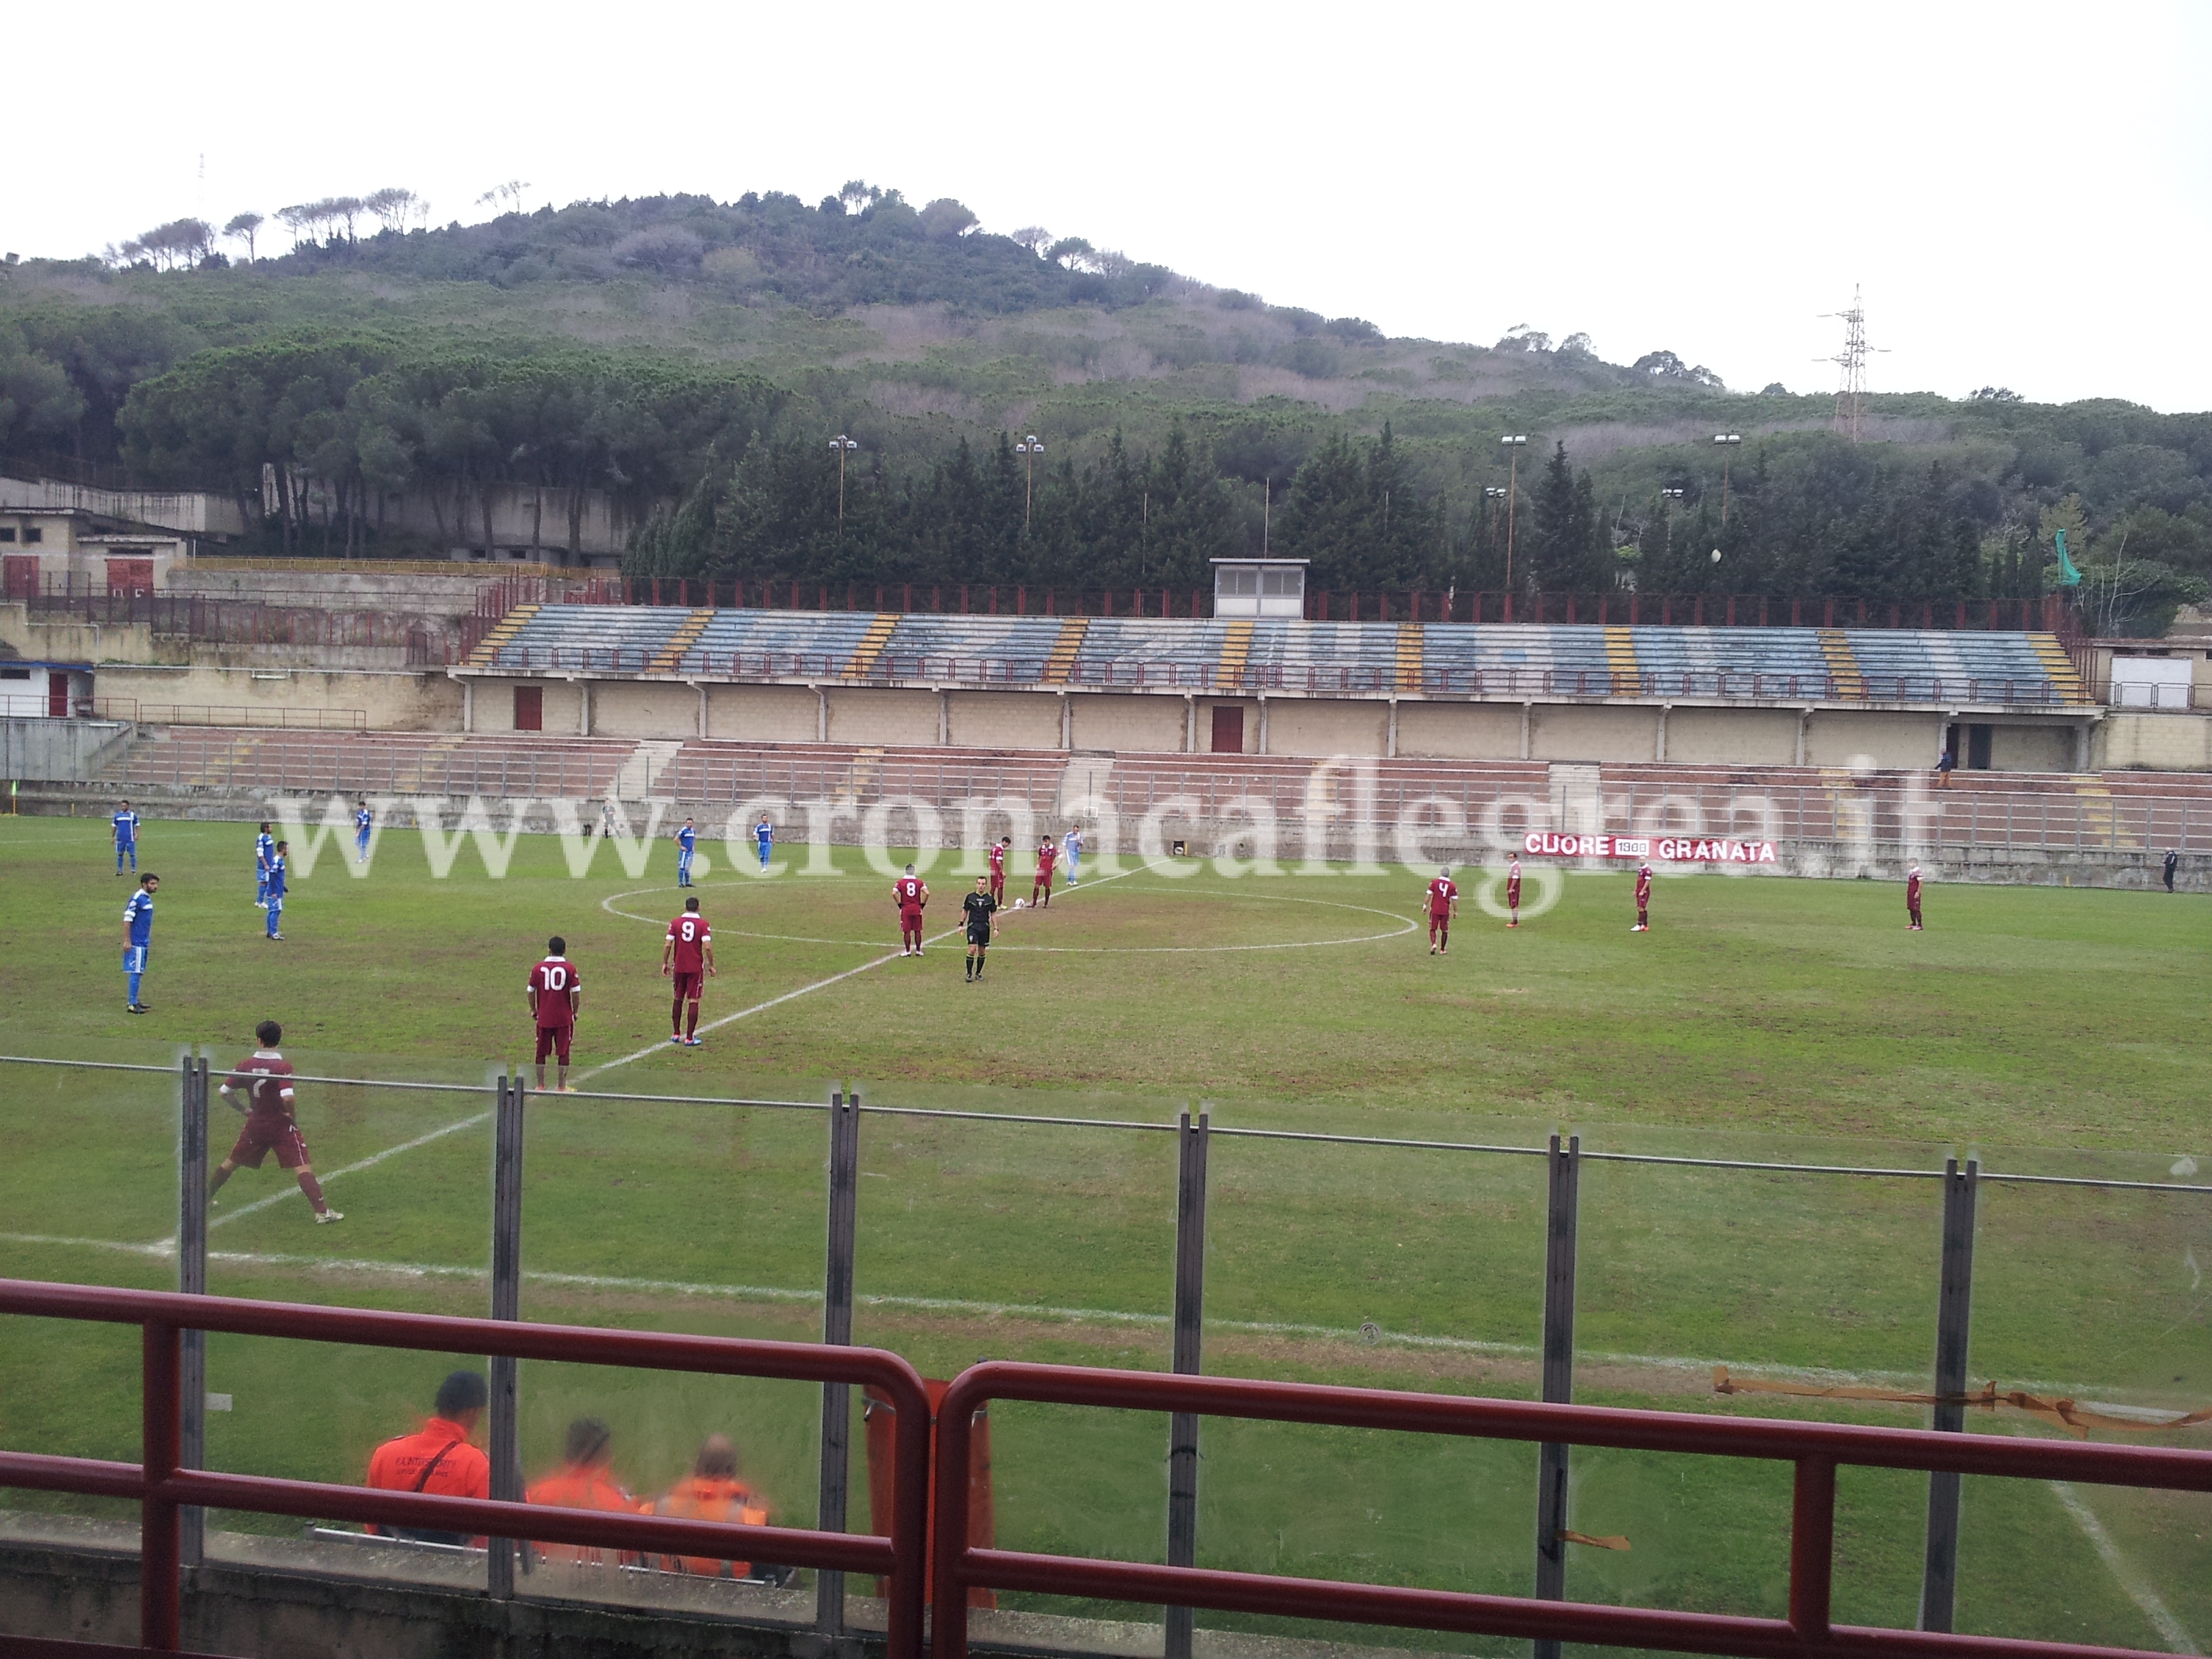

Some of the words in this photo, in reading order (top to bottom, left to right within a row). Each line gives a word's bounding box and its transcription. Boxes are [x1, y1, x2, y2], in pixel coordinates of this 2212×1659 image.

[1525, 833, 1610, 856] CUORE
[1659, 840, 1776, 861] GRANATA
[906, 882, 916, 897] 8
[1439, 882, 1448, 897] 4
[681, 921, 695, 942] 9
[540, 966, 567, 990] 10
[252, 1068, 270, 1098] 7
